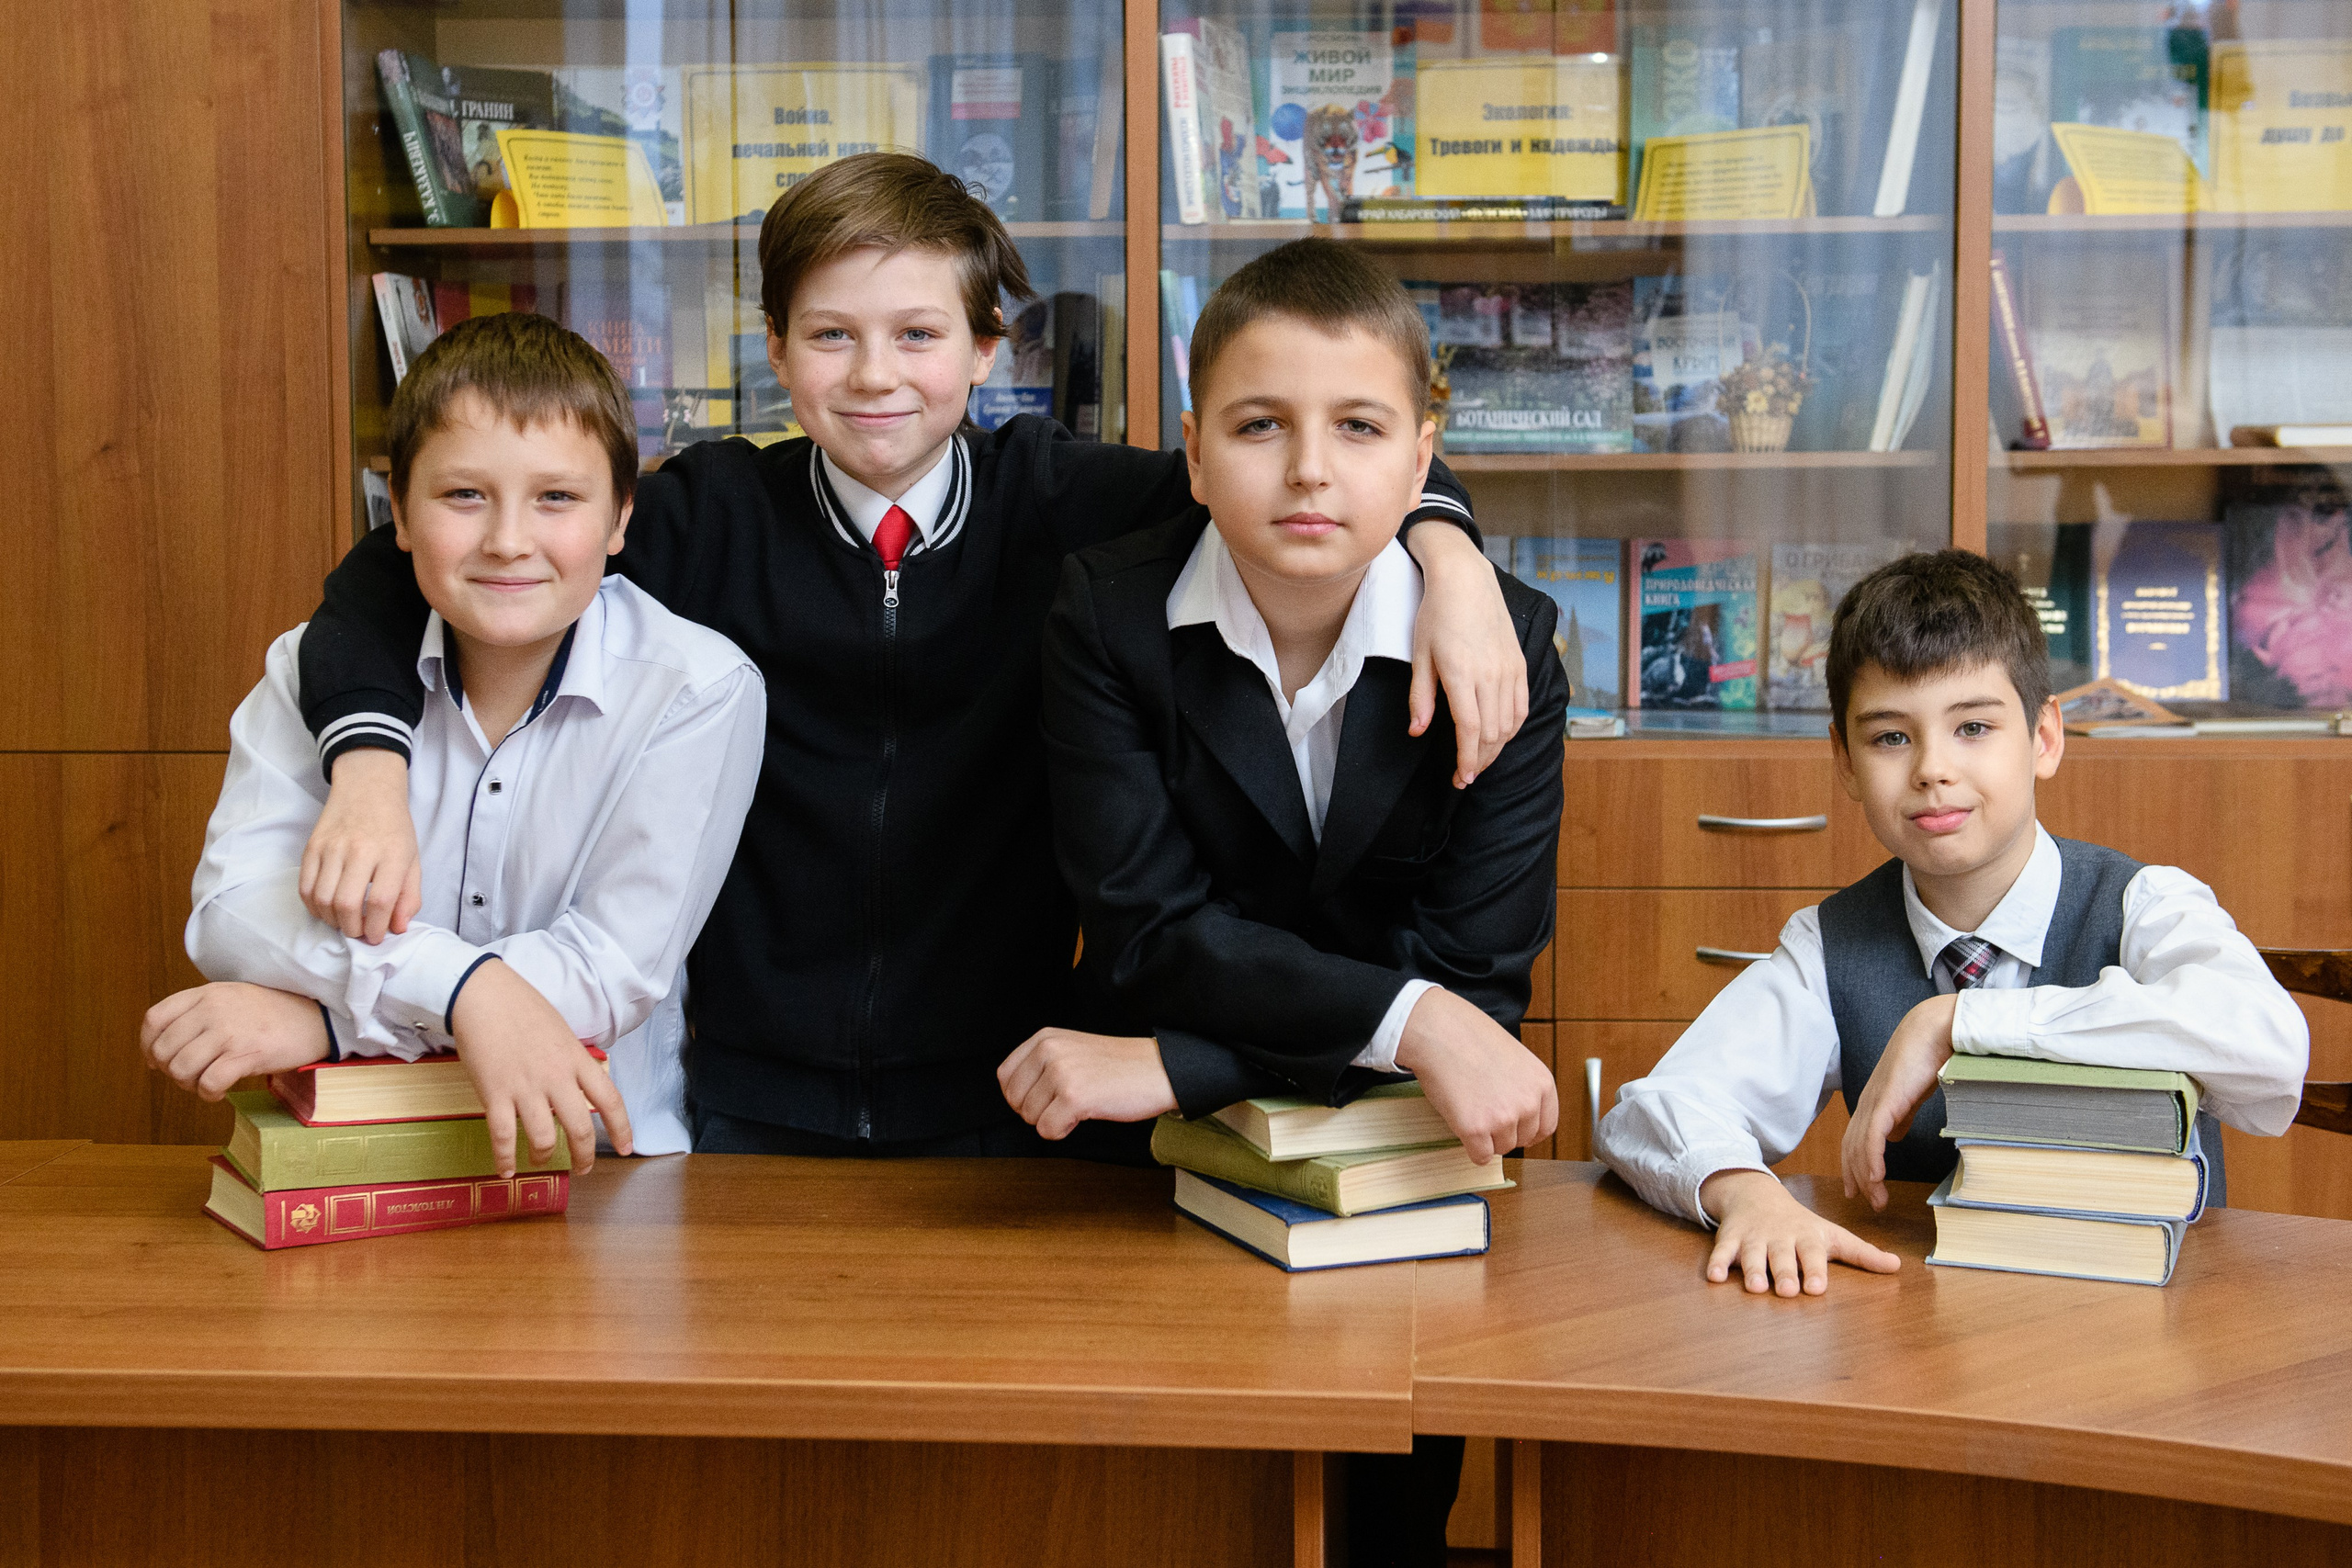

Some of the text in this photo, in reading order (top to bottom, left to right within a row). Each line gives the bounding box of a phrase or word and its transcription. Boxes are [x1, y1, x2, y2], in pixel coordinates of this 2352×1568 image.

[1294, 46, 1372, 64] ЖИВОЙ
[1308, 68, 1356, 83] МИР
[1281, 85, 1382, 96] ЭНЦИКЛОПЕДИЯ
[461, 99, 514, 120] ГРАНИН
[774, 106, 833, 126] Война,
[1482, 102, 1574, 121] Экология:
[731, 138, 830, 159] печальней
[1430, 139, 1619, 157] Тревоги и надежды
[402, 130, 437, 209] КАЗАКЕВИЧ
[589, 336, 662, 355] АМЯТИ
[638, 366, 647, 388] 1
[1456, 405, 1602, 429] БОТАНИЧЕСКИЙ САД
[1645, 593, 1680, 607] КНИГА
